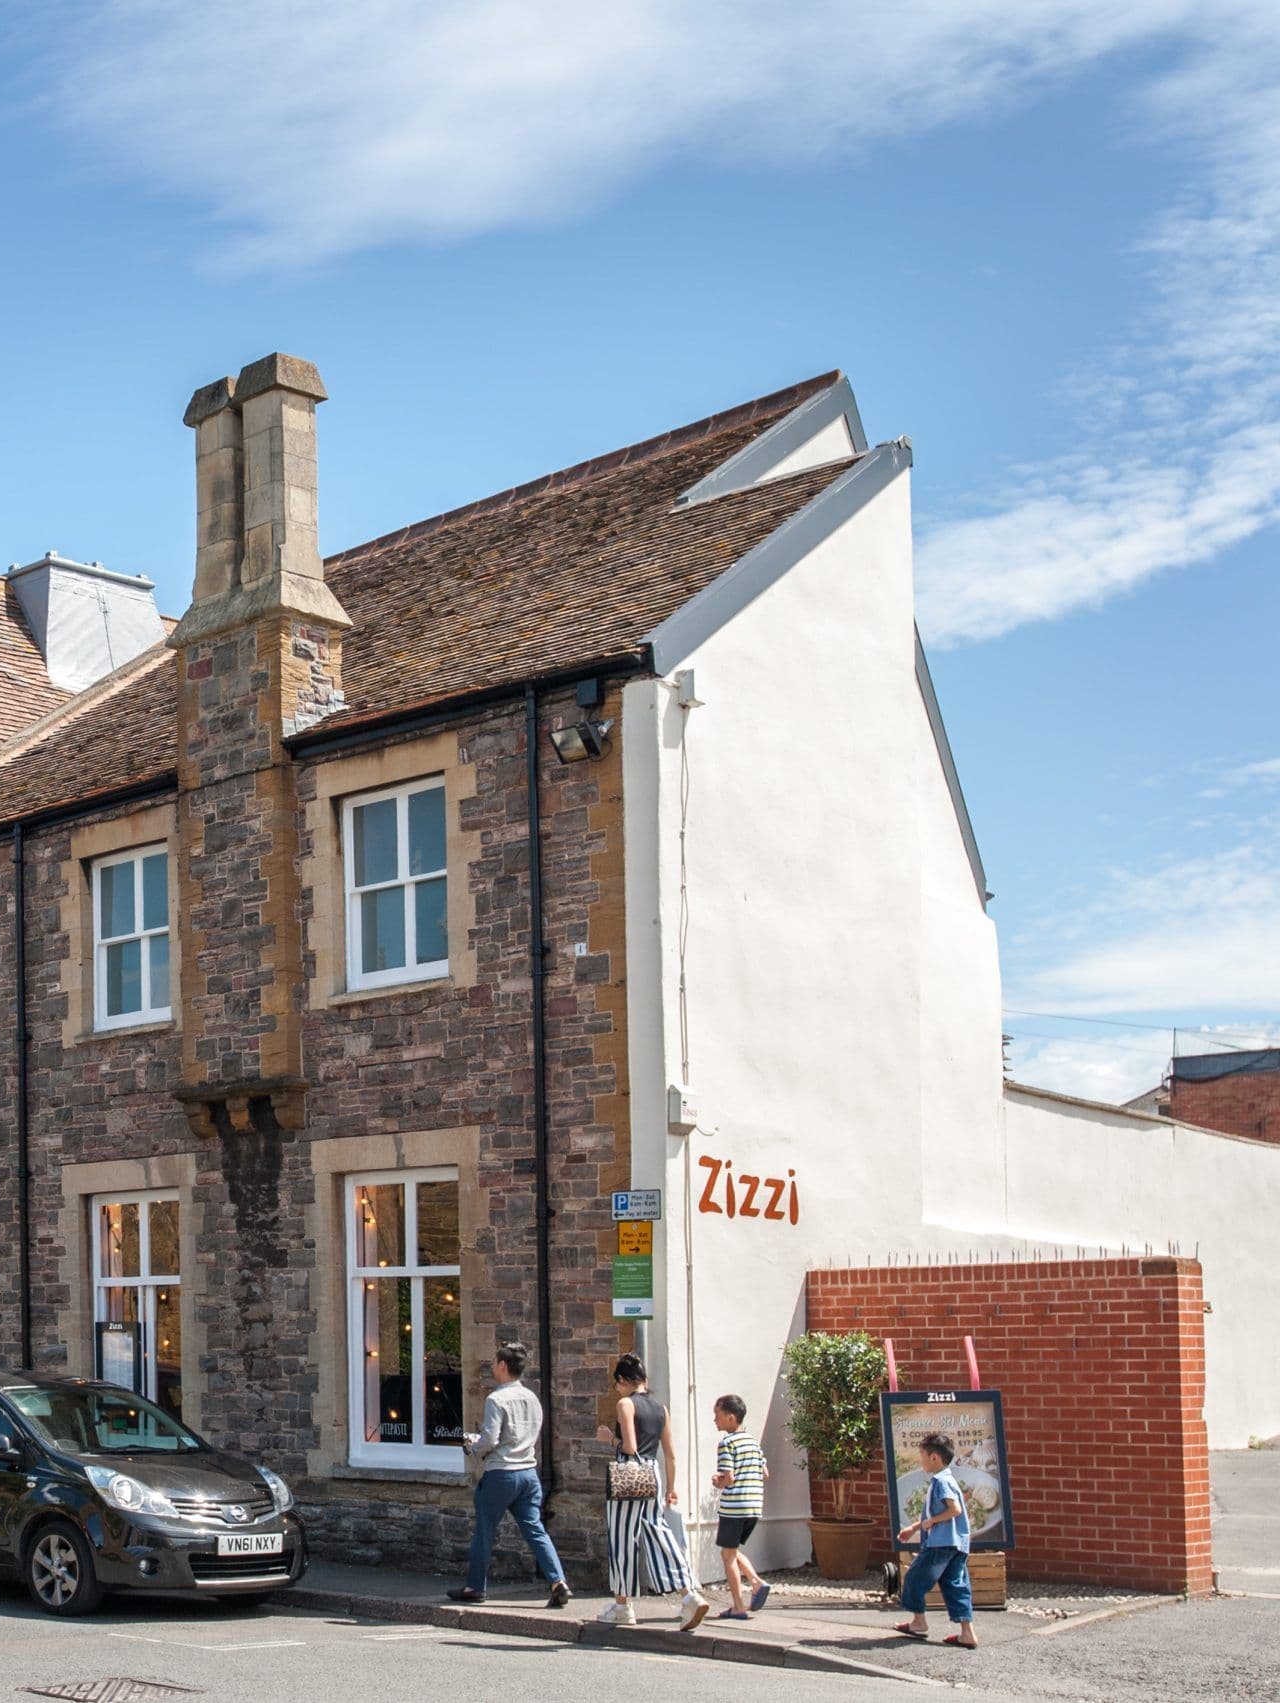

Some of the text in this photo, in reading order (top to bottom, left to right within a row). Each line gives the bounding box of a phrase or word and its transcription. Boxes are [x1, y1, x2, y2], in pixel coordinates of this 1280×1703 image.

[698, 1155, 799, 1226] Zizzi
[618, 1196, 627, 1209] P
[927, 1392, 956, 1402] Zizzi
[896, 1414, 987, 1430] Summer Set Menu
[227, 1536, 276, 1552] VN61 NXY
